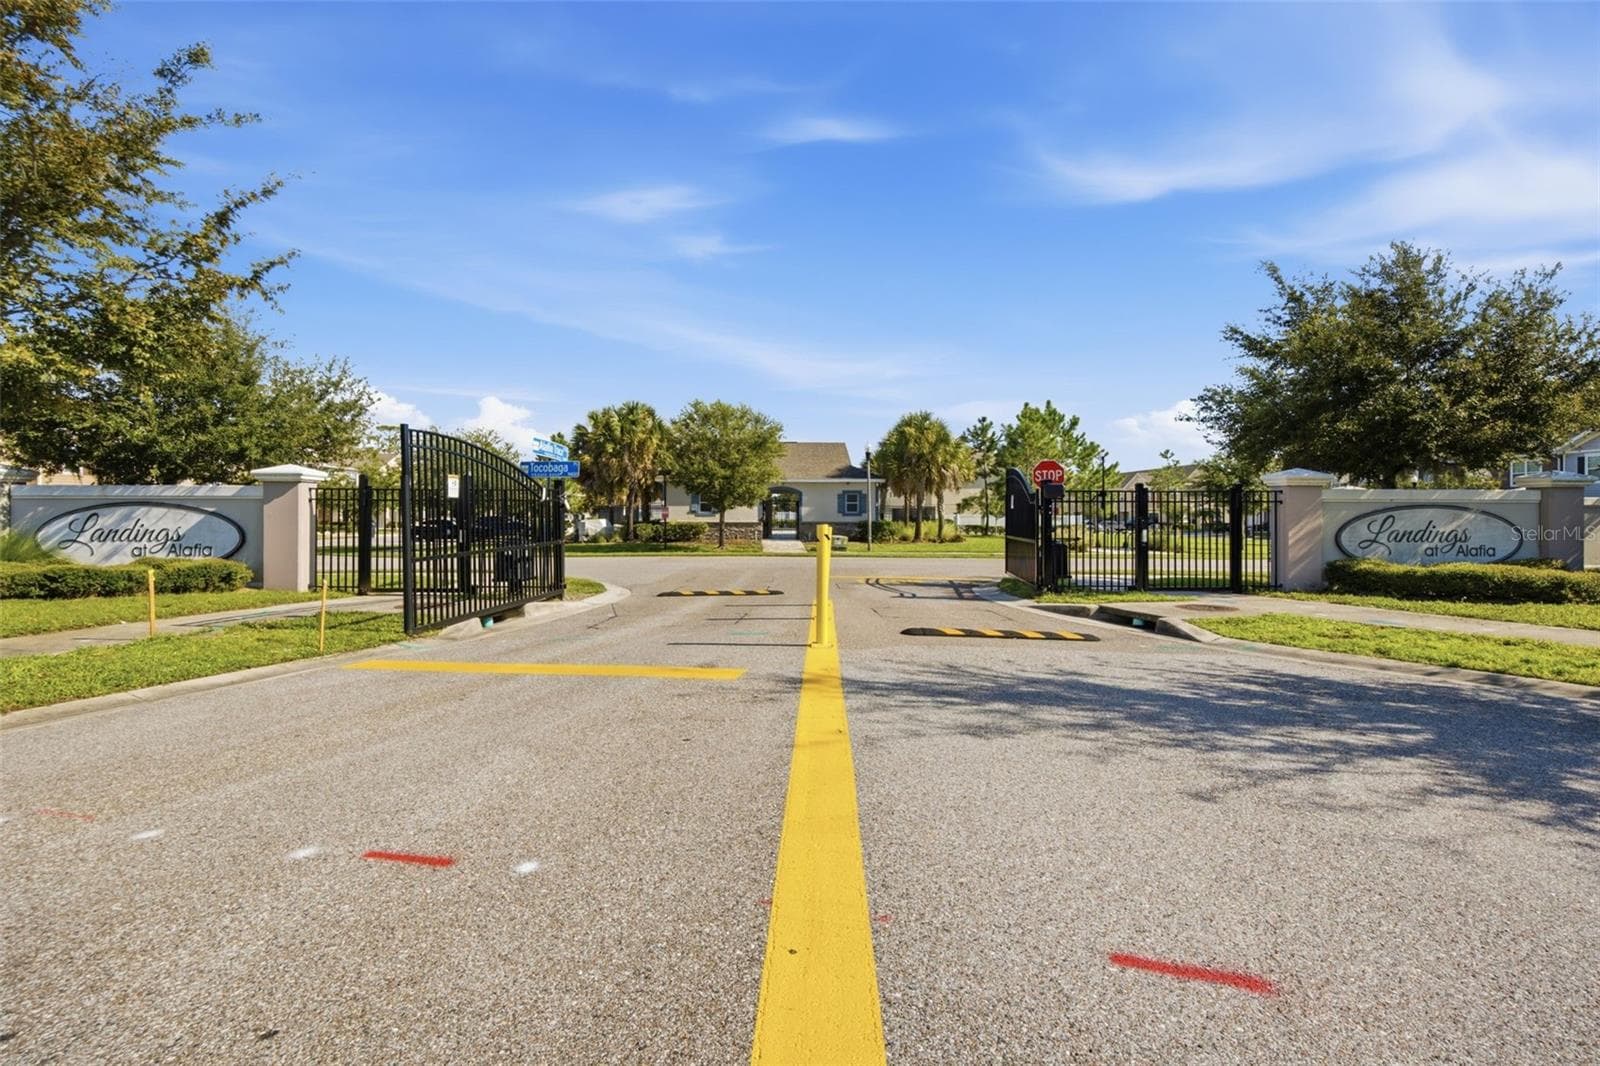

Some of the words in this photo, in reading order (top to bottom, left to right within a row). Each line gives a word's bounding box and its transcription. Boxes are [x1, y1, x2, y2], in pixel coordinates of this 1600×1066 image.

[530, 462, 568, 475] Tocobaga
[1034, 469, 1063, 482] STOP
[58, 512, 186, 556] Landings
[1358, 515, 1471, 556] Landings
[131, 544, 147, 558] at
[166, 543, 213, 558] Alafia
[1424, 545, 1440, 557] at
[1456, 545, 1497, 557] Alafia
